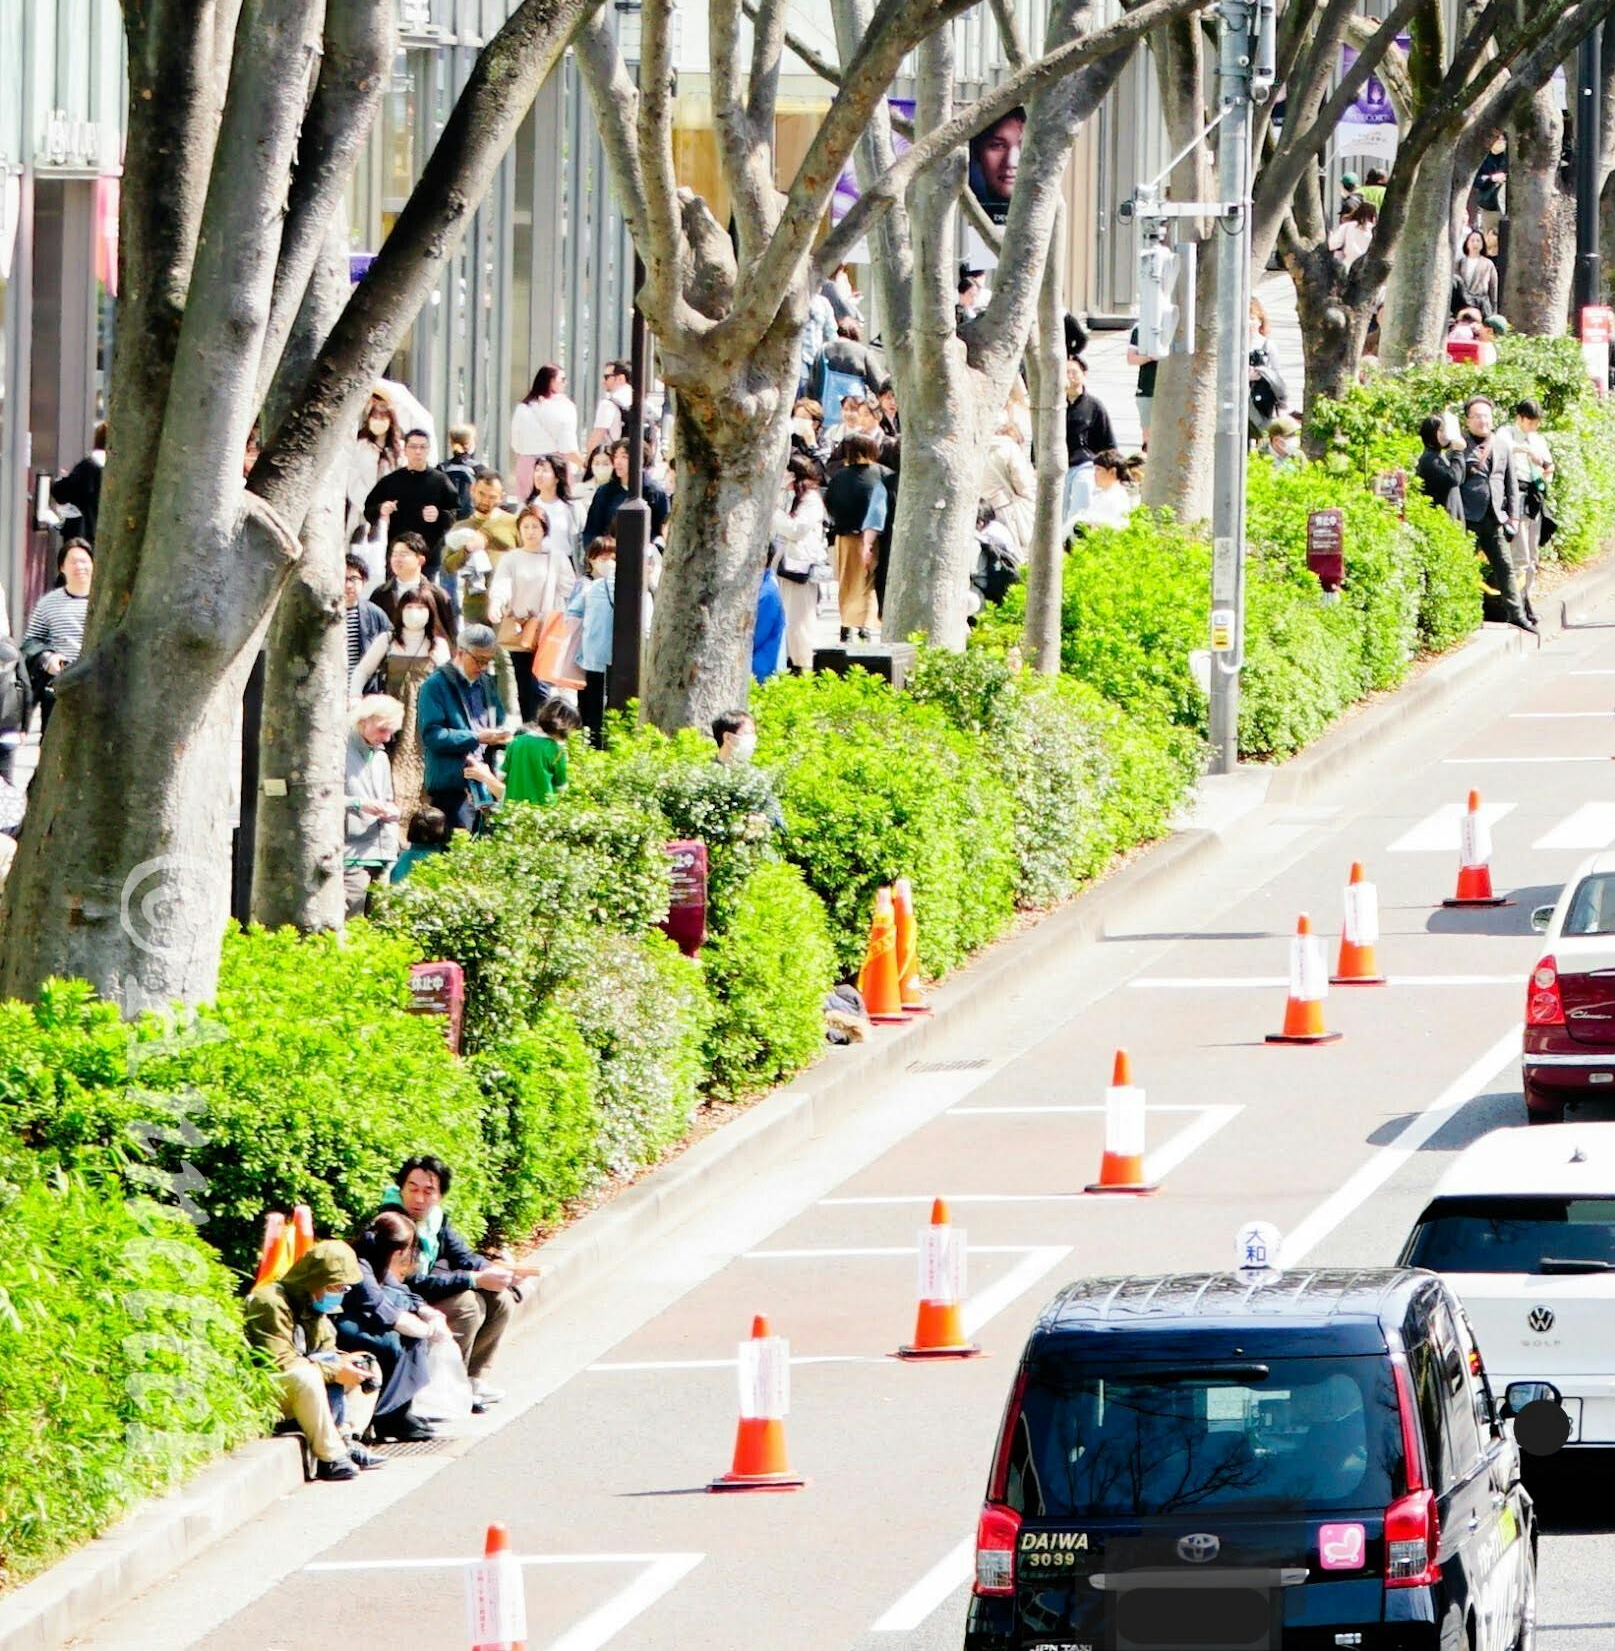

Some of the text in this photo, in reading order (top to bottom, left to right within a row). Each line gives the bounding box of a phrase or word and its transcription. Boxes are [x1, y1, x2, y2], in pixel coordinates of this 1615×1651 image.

[1245, 1228, 1266, 1263] 大和
[1520, 1339, 1562, 1347] GOLF
[1021, 1532, 1089, 1551] DAIWA
[1029, 1552, 1076, 1567] 3039
